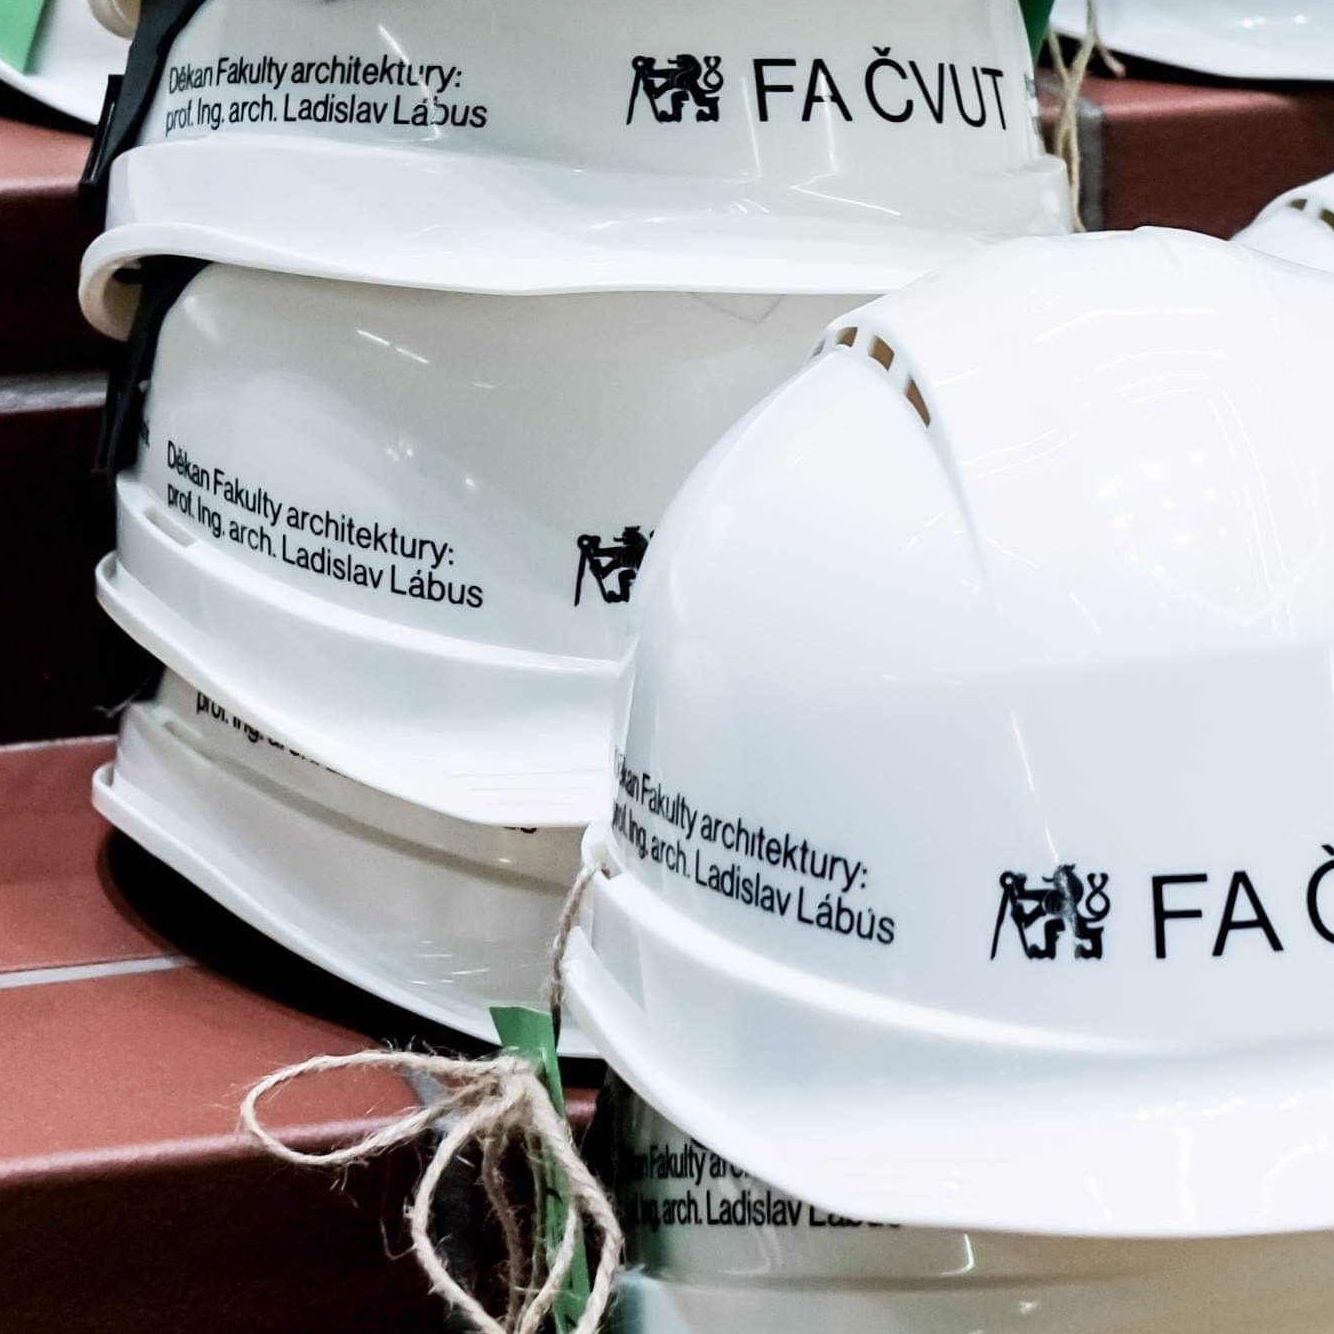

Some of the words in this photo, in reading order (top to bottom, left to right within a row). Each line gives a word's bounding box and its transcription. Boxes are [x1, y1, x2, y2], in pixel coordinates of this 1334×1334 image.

[165, 102, 194, 138] prof.
[196, 97, 227, 131] Ing.
[229, 94, 278, 124] arch.
[283, 93, 388, 124] Ladislav
[168, 64, 213, 95] Děkan
[216, 56, 287, 90] Fakulty
[290, 54, 463, 94] architektury:
[753, 58, 851, 123] FA
[864, 46, 1009, 132] ČVUT
[166, 439, 212, 493] Děkan
[212, 467, 283, 527] Fakulty
[286, 504, 456, 569] architektury:
[166, 481, 196, 519] prof.
[197, 494, 227, 539] Ing.
[228, 516, 278, 560] arch.
[281, 533, 385, 590] Ladislav
[389, 564, 485, 610] Lábus
[640, 772, 698, 840] Fakulty
[699, 812, 869, 893] architektury:
[650, 834, 691, 879] arch.
[694, 848, 793, 918] Ladislav
[796, 885, 897, 946] Lábus
[1152, 871, 1286, 961] FA
[706, 1188, 802, 1227] Ladislav
